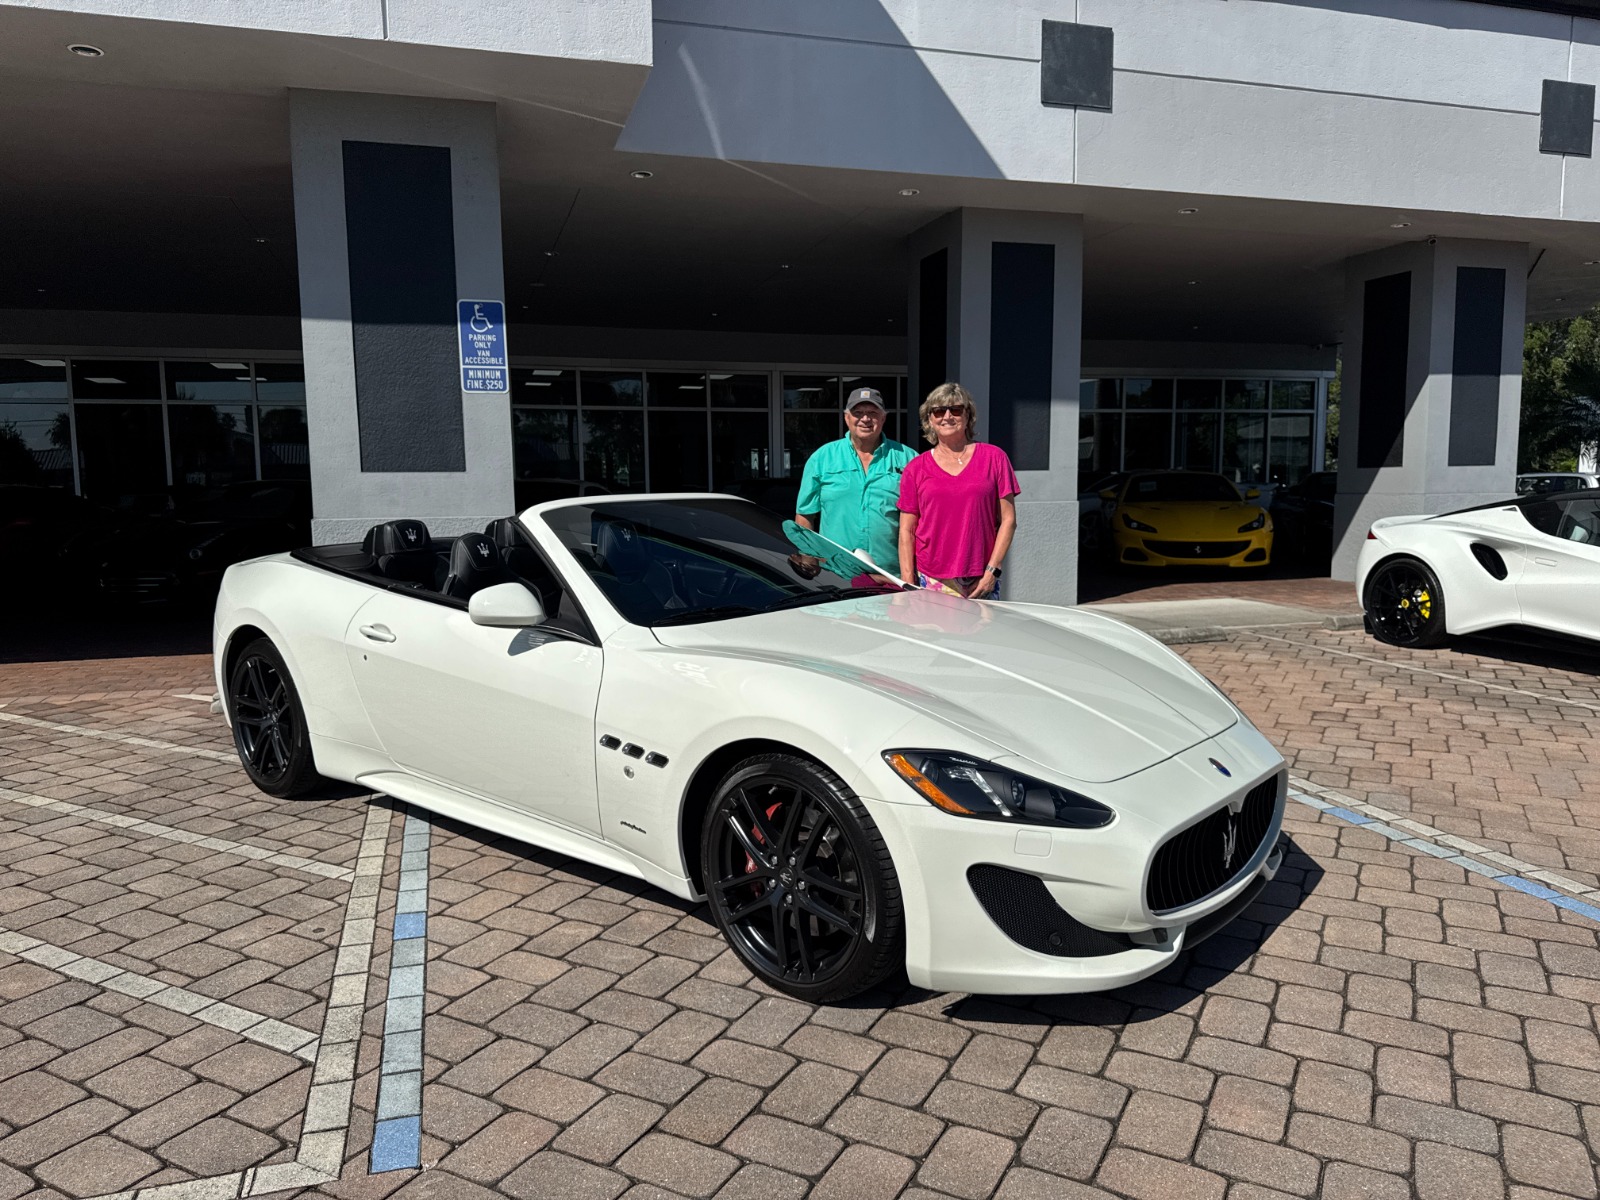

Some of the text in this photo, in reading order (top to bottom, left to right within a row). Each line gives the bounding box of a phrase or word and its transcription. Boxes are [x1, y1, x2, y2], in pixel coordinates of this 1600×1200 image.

[468, 370, 501, 379] MINIMUM
[467, 380, 503, 390] FINE $250
